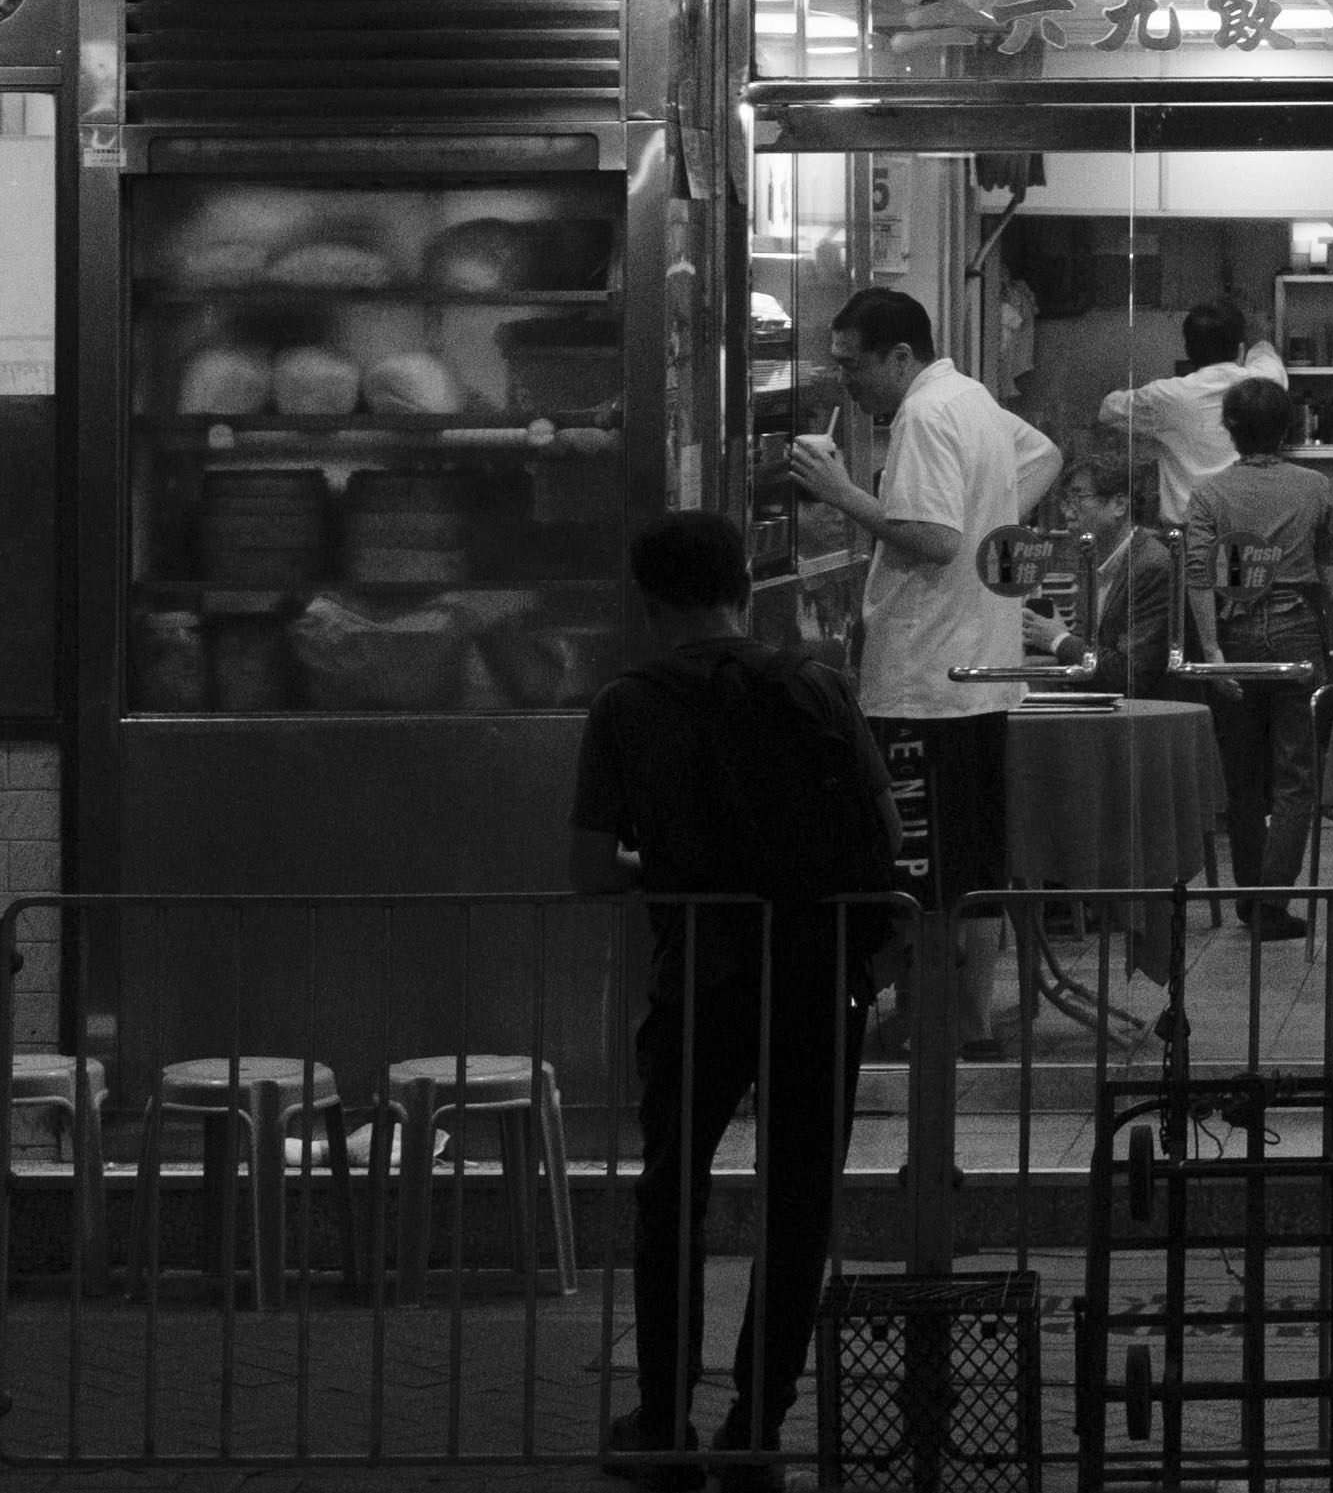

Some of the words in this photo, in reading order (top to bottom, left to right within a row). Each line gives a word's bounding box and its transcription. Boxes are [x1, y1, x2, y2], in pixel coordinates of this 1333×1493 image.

[1013, 540, 1053, 559] Push
[1242, 544, 1283, 562] Push
[1016, 561, 1038, 585] 推
[1244, 565, 1267, 589] 推
